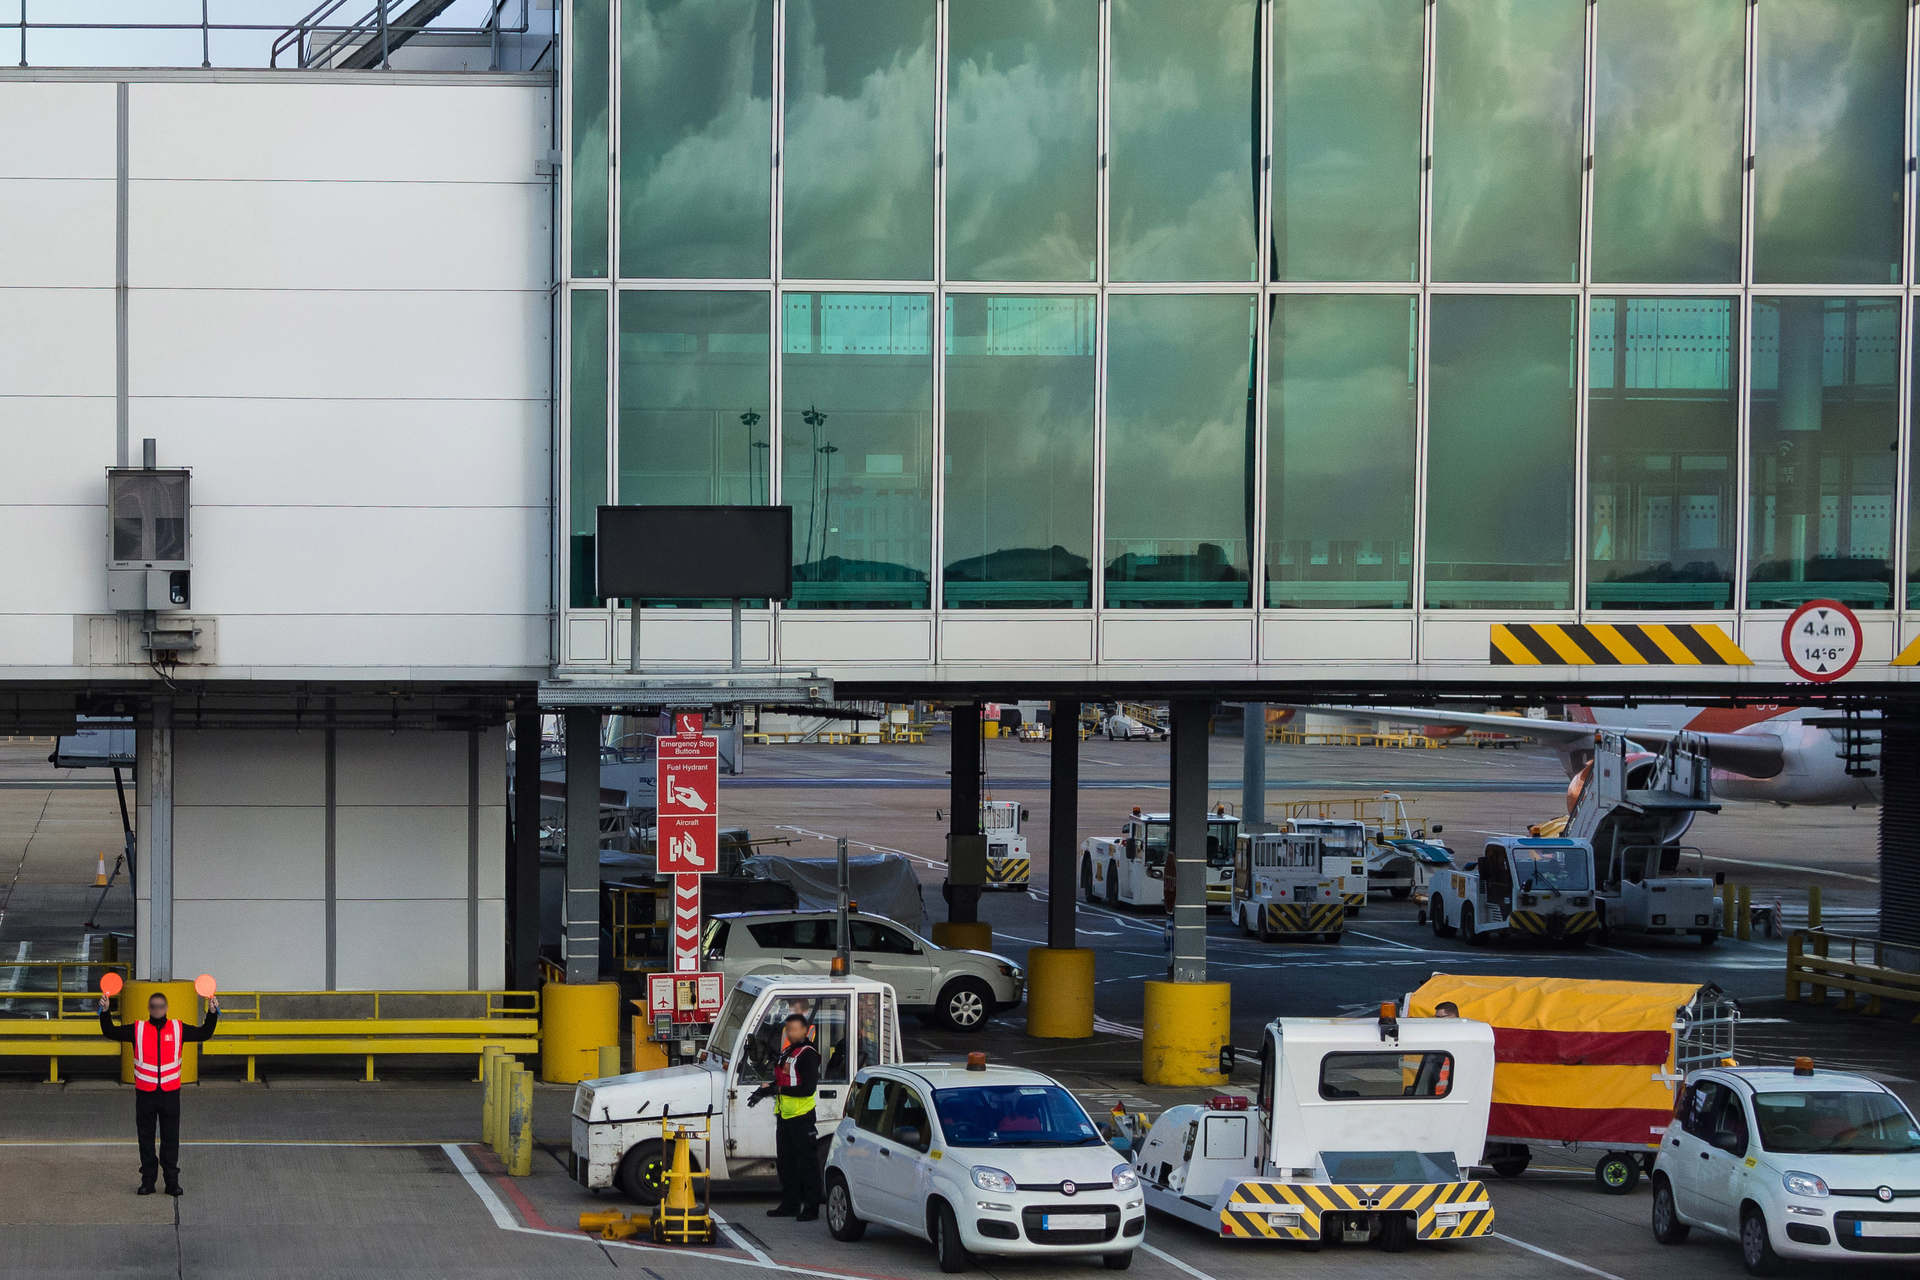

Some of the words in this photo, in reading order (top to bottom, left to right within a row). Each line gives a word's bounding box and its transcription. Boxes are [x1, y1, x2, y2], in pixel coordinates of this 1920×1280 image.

[1803, 622, 1830, 636] 4.4
[1834, 627, 1846, 637] m
[682, 764, 709, 772] Hydrant
